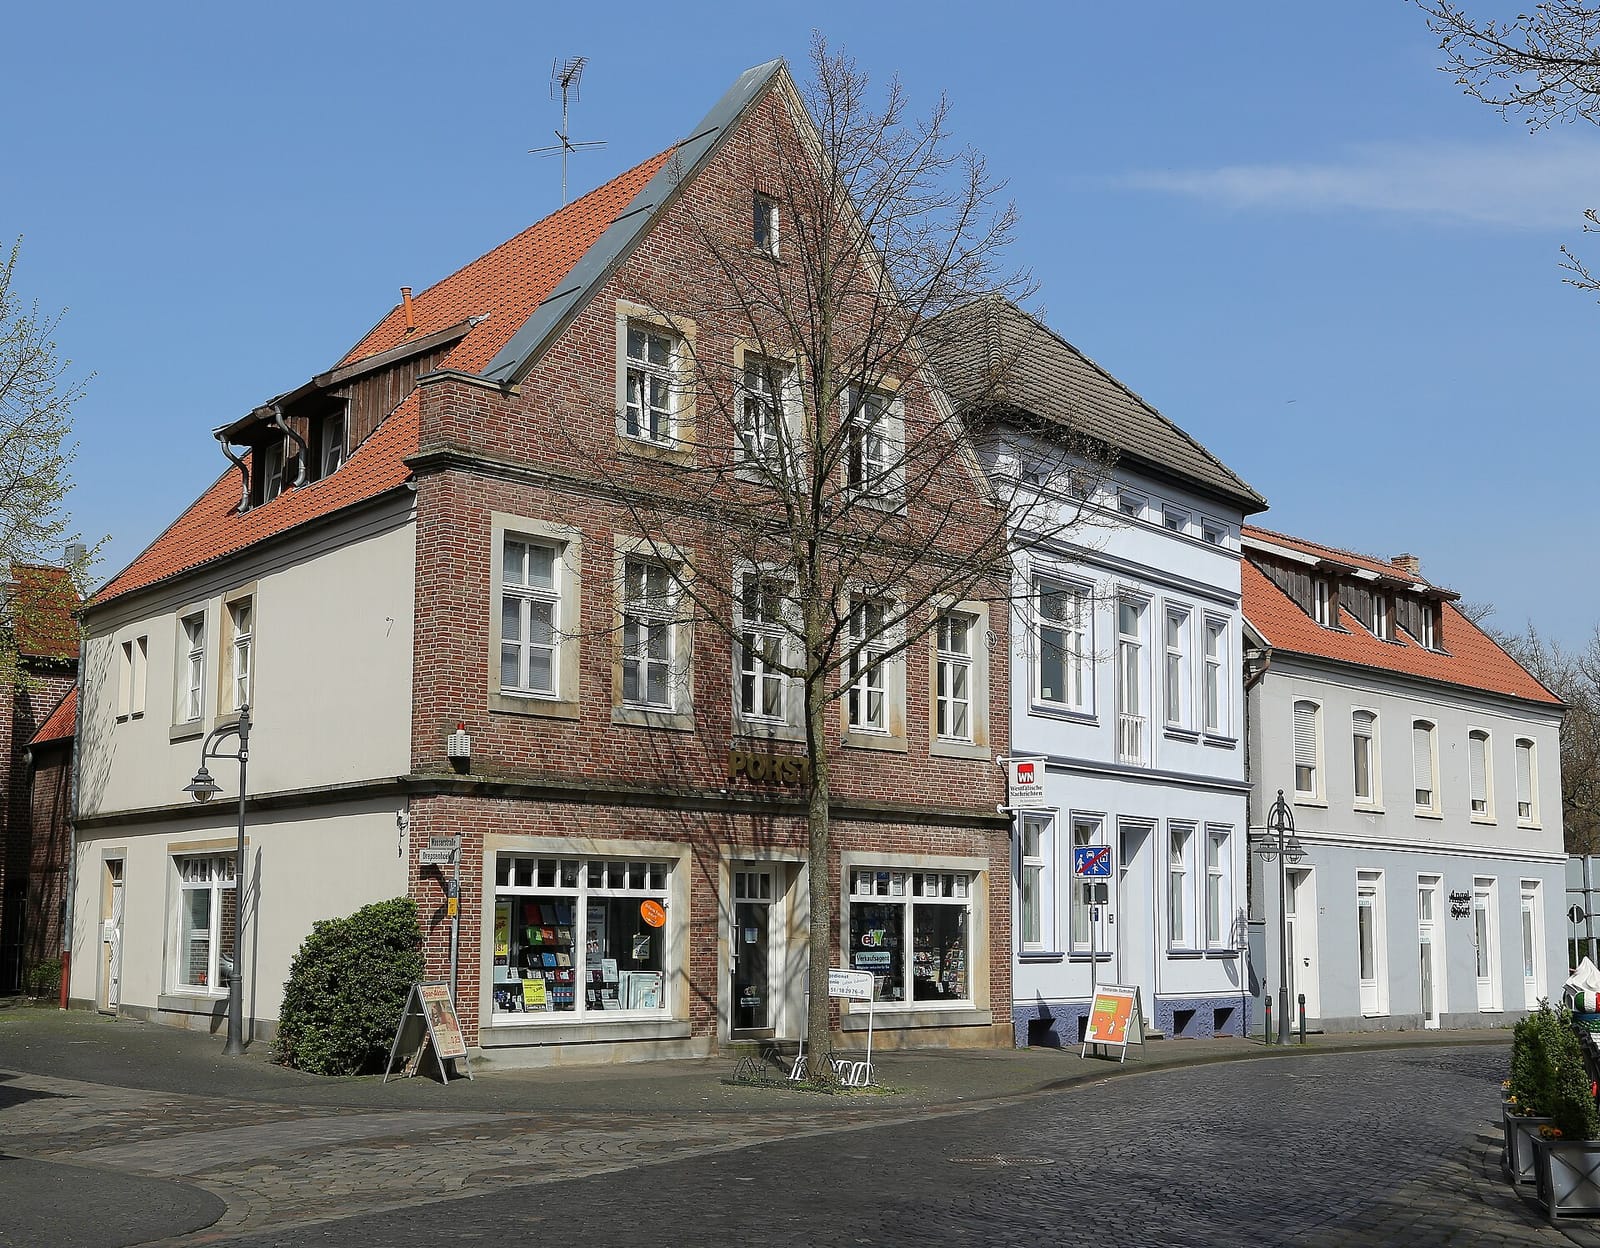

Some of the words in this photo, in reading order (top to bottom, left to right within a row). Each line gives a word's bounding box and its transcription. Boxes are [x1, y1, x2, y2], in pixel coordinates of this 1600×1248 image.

[728, 752, 809, 784] PORST
[1018, 772, 1034, 783] WN
[1451, 904, 1470, 920] Sport
[856, 954, 890, 963] Verkaufsagent
